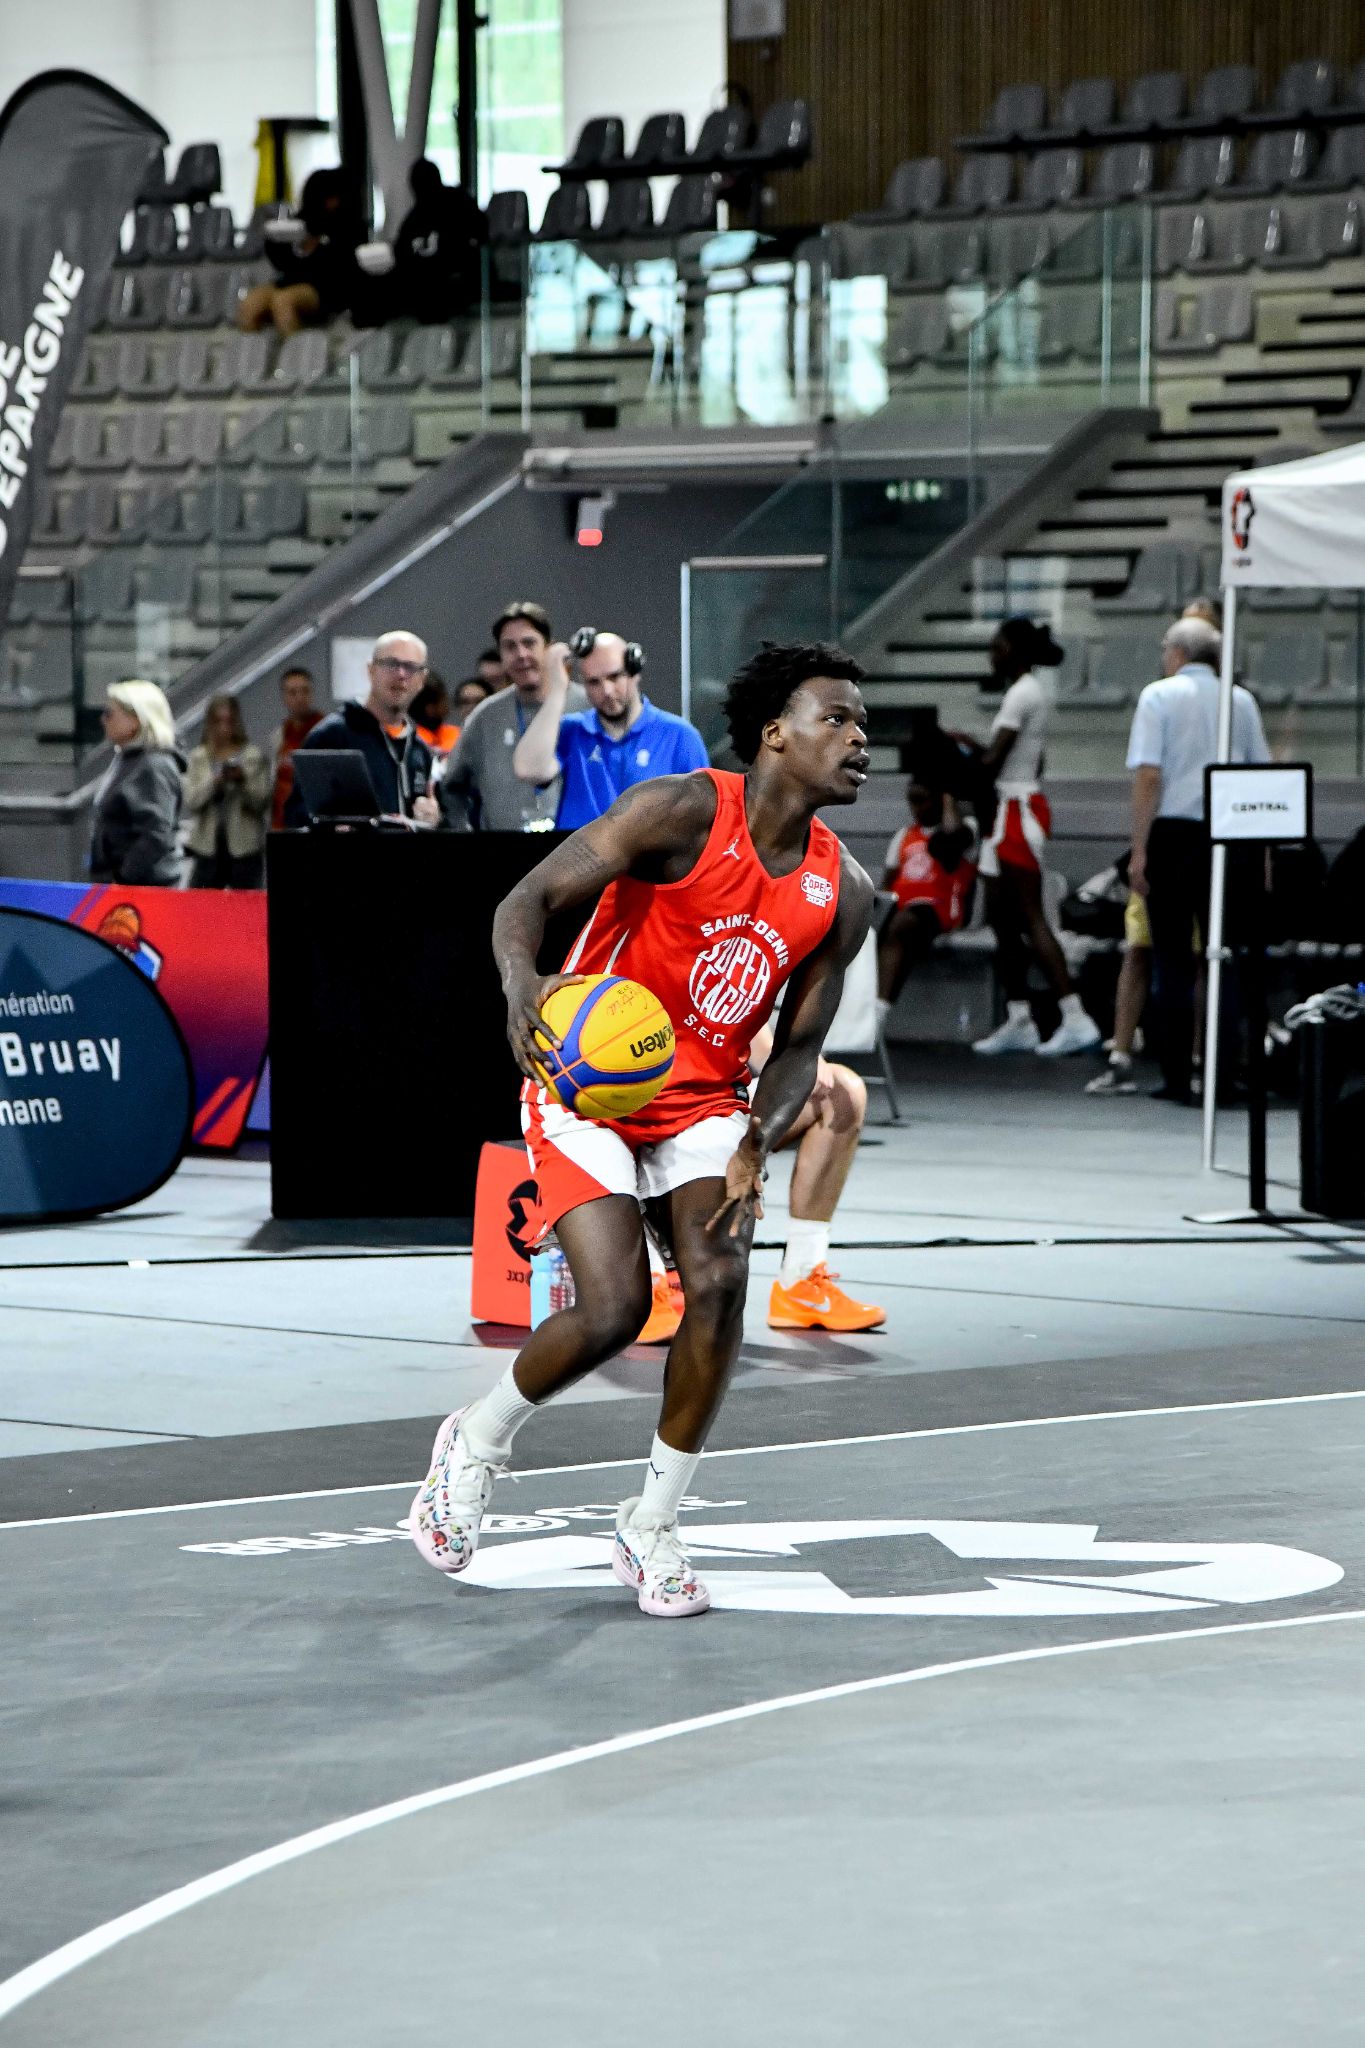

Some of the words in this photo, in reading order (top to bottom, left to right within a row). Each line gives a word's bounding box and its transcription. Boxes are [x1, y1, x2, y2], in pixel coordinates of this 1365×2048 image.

[0, 249, 85, 558] EPARGNE
[1231, 802, 1288, 813] CENTRAL
[700, 913, 789, 969] SAINT-DENIS
[700, 936, 771, 1002] SUPER
[0, 1031, 121, 1082] Bruay
